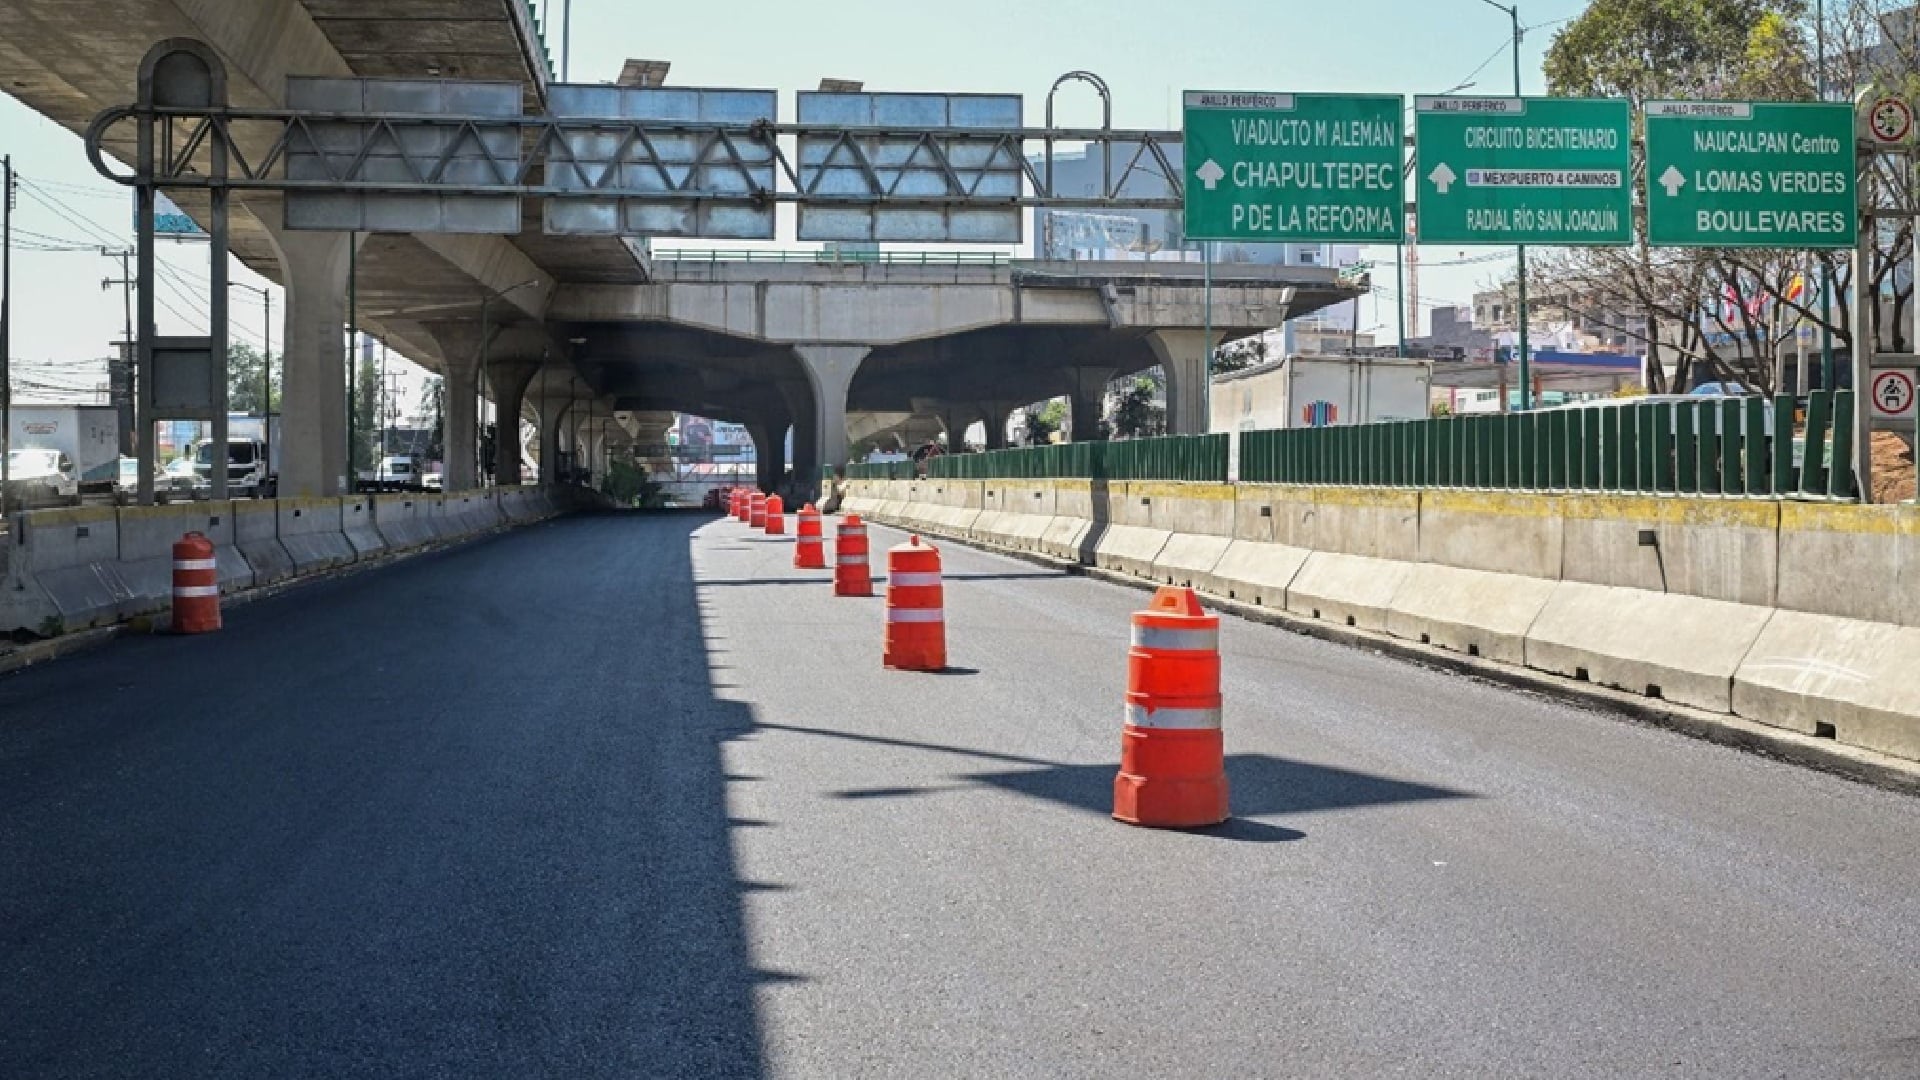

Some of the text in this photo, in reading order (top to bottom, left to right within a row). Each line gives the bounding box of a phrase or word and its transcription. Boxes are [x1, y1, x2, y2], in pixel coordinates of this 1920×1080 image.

[1231, 114, 1395, 147] VIADUCTO M ALEMÁN
[1464, 127, 1617, 150] CIRCUITO BICENTENARIO
[1693, 131, 1840, 154] NAUCALPAN Centro
[1232, 161, 1394, 190] CHAPULTEPEC
[1482, 172, 1617, 185] MEXIPUERTO 4 CAMINOS
[1695, 170, 1846, 193] LOMAS VERDES
[1231, 204, 1395, 233] P DE LA REFORMA
[1466, 203, 1618, 233] RADIAL RÍO SAN JOAQUÍN
[1696, 210, 1846, 233] BOULEVARES
